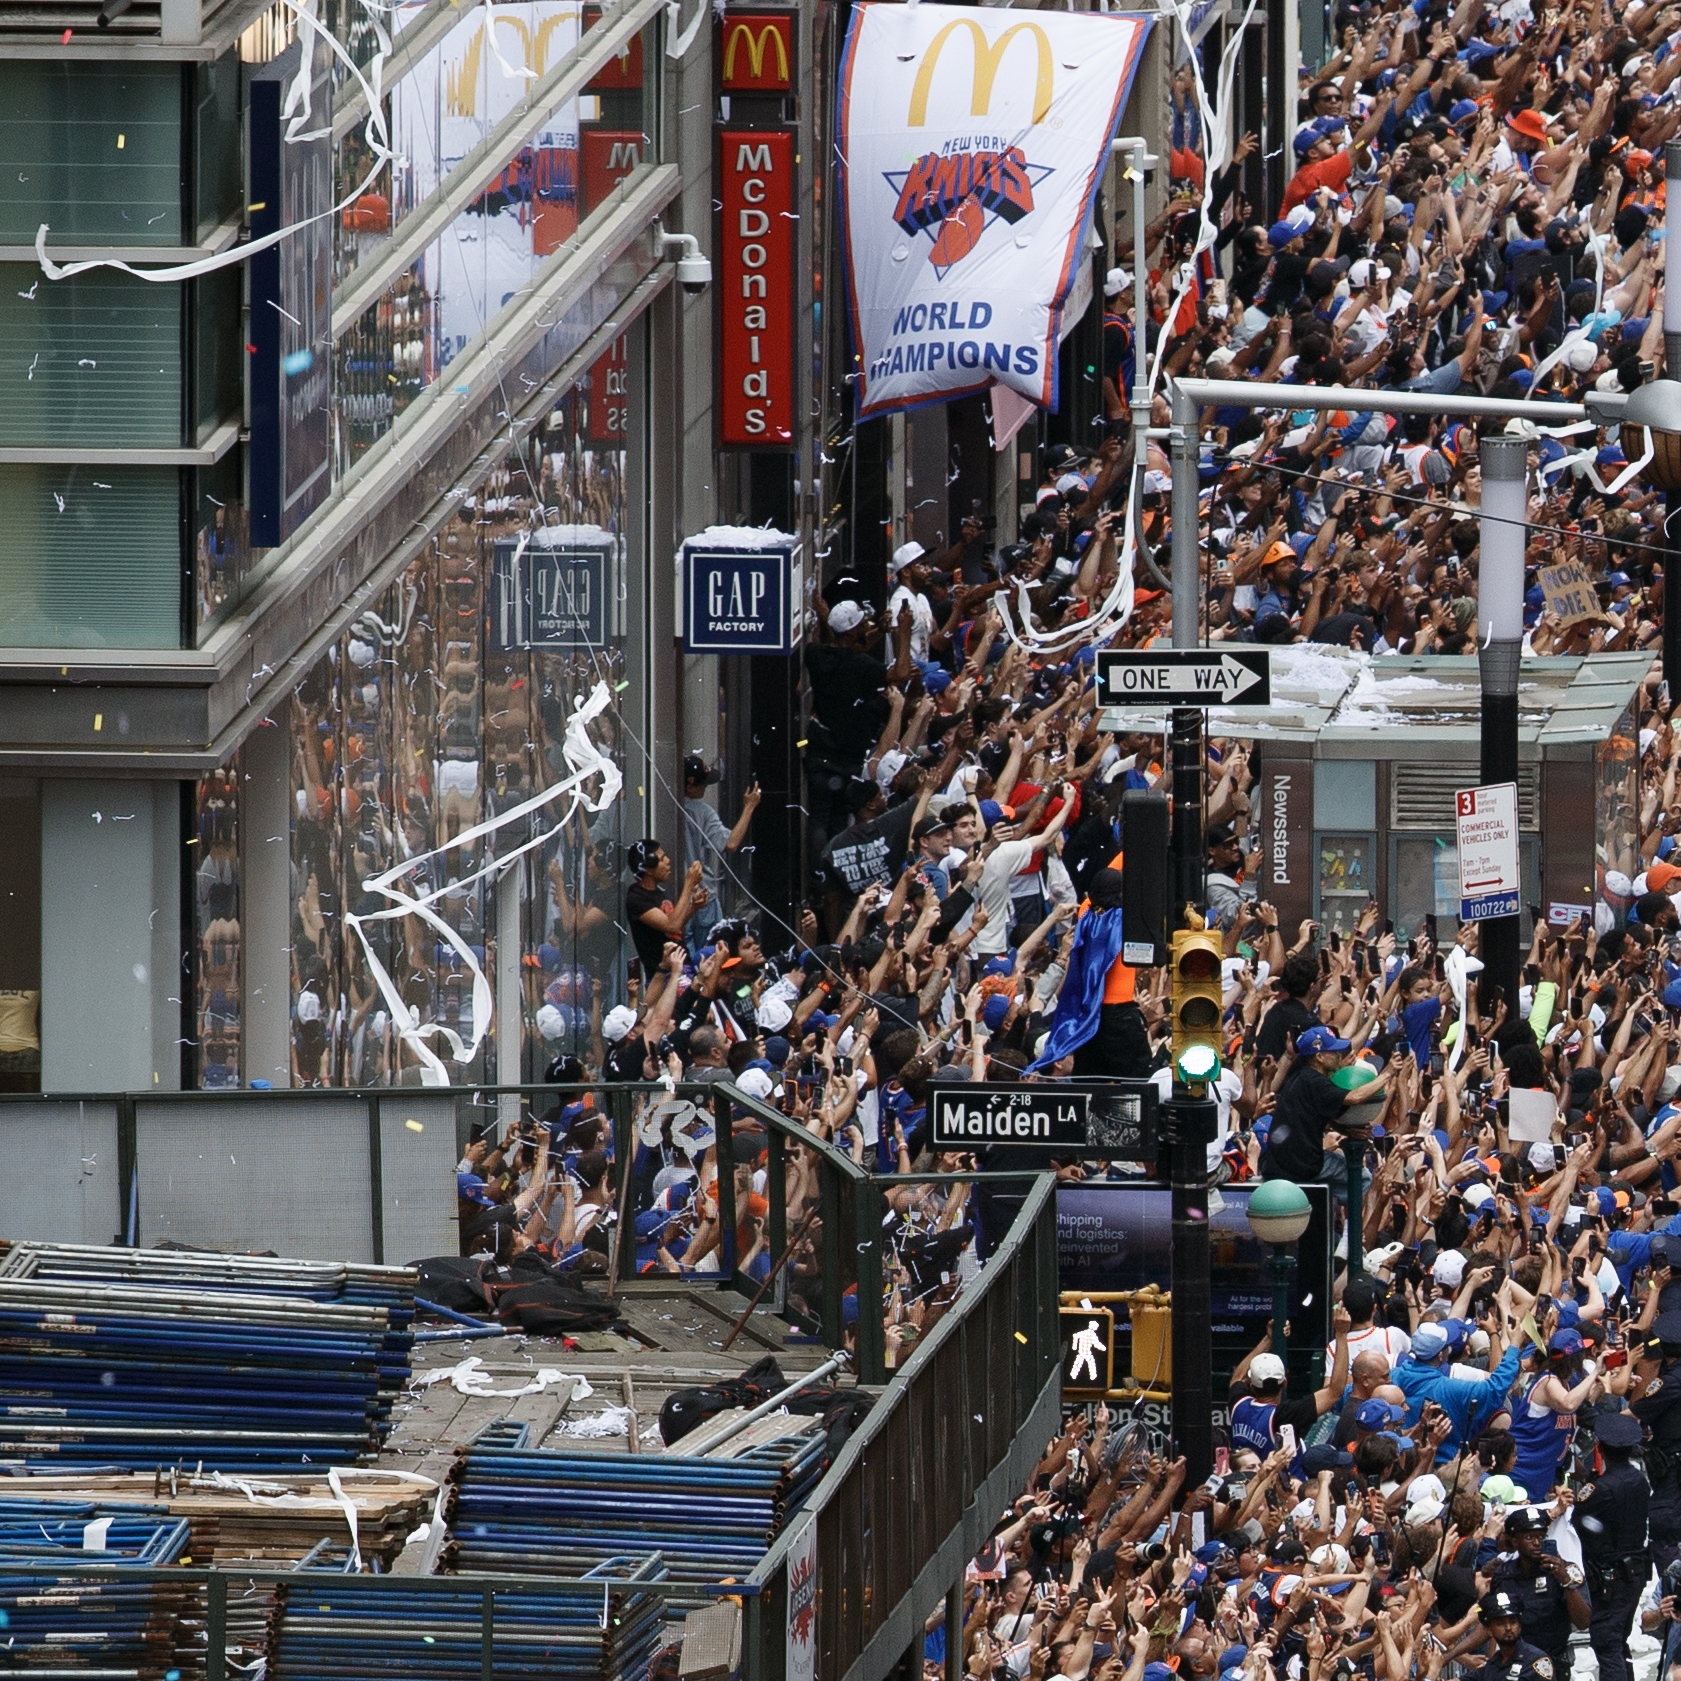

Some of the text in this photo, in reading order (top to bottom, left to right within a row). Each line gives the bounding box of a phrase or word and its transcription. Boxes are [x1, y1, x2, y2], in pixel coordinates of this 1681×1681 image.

[942, 137, 972, 156] NEW
[736, 144, 774, 434] McDonald's
[892, 302, 993, 335] WORLD
[708, 570, 765, 618] GAP
[708, 620, 765, 632] FACTORY
[1122, 668, 1244, 690] ONE WAY
[1461, 792, 1471, 815] 3
[1273, 774, 1291, 885] Newsstand
[1461, 819, 1505, 835] COMMERCIAL
[1462, 829, 1510, 846] VEHICLES ONLY
[1470, 902, 1505, 918] 100722
[1009, 1095, 1032, 1106] 2-18
[943, 1103, 1076, 1136] Maiden LA
[1076, 1226, 1129, 1243] logistics:
[1144, 1402, 1172, 1425] St
